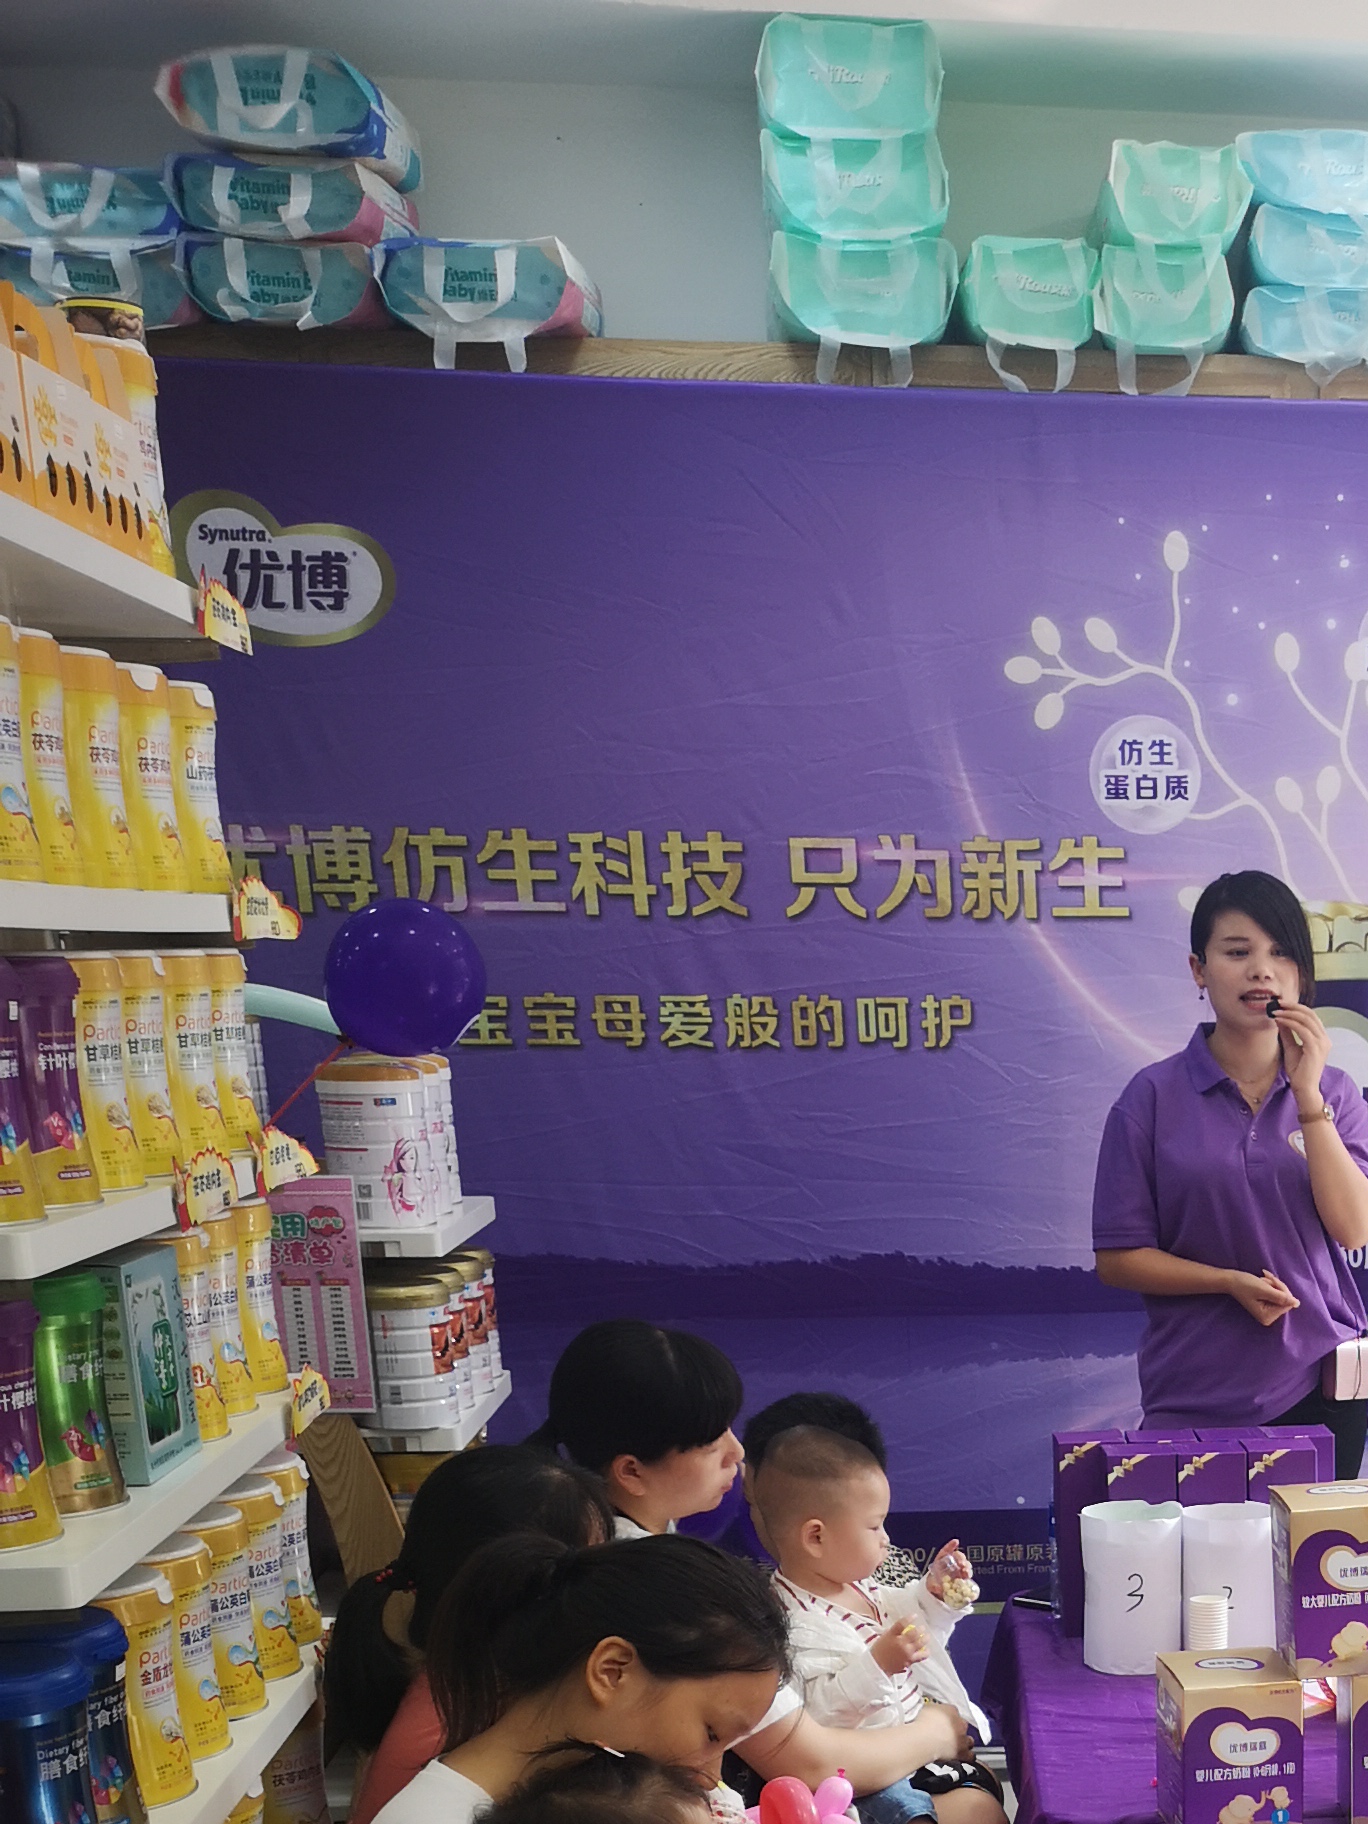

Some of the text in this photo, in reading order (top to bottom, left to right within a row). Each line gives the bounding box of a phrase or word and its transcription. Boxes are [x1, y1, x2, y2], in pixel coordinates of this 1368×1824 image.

[222, 546, 350, 613] 优博
[1118, 739, 1175, 768] 仿生
[1104, 774, 1190, 803] 蛋白质
[226, 825, 1129, 921] 优博仿生科技 只为新生
[997, 1563, 1025, 1575] From
[1126, 1573, 1145, 1613] 3
[1301, 1592, 1361, 1608] 较大婴儿配方奶粉
[1195, 1767, 1250, 1782] 婴儿配方奶粉
[1276, 1810, 1284, 1823] 1
